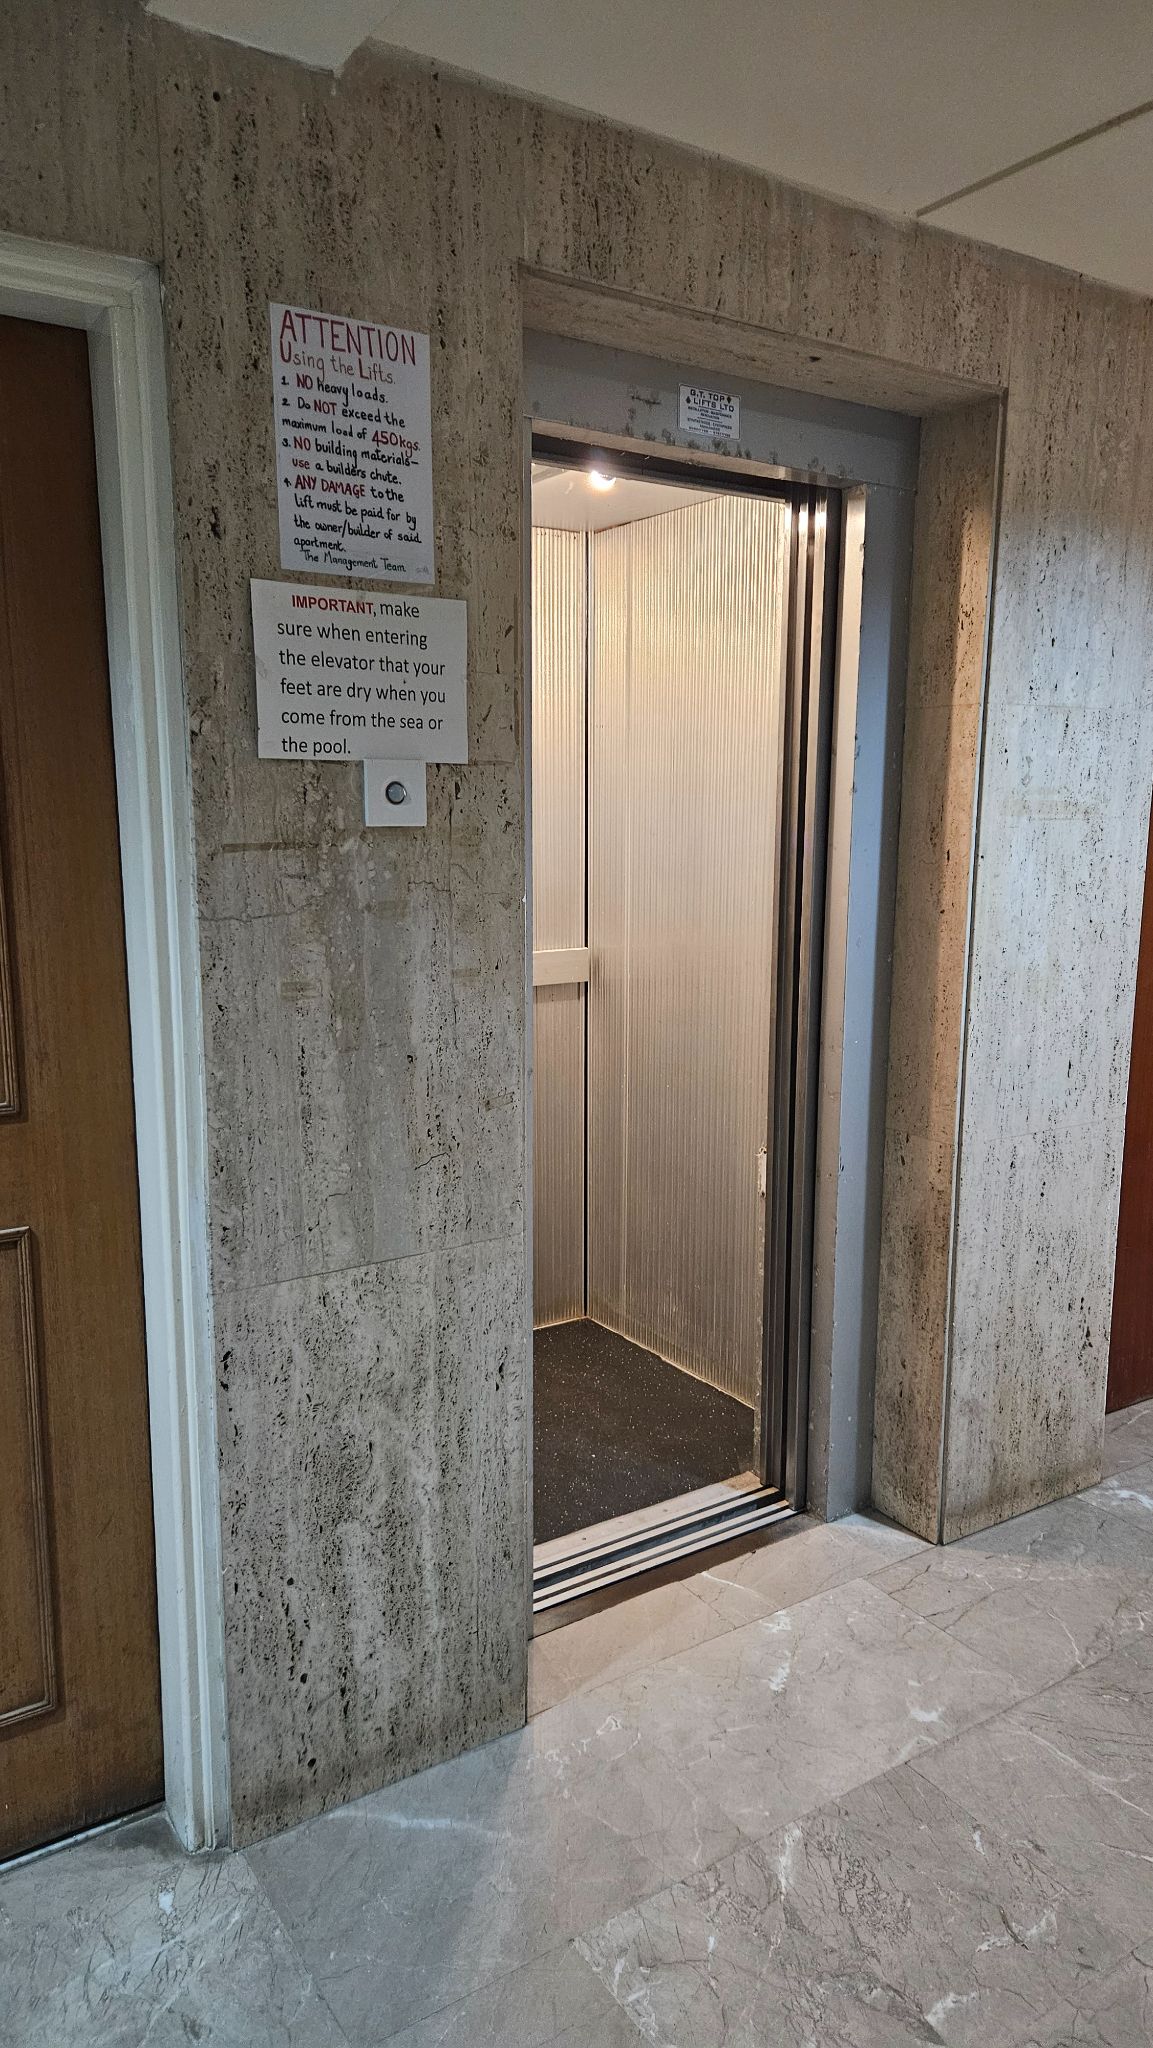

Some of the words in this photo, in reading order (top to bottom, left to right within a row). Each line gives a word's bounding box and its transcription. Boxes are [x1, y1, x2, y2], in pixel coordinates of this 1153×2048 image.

[280, 310, 416, 366] ATTENTION
[280, 340, 325, 382] Using
[330, 355, 354, 376] the
[296, 373, 314, 390] NO
[317, 377, 349, 407] heavy
[352, 383, 388, 404] loads.
[708, 392, 725, 402] TOP
[297, 397, 311, 410] Do
[314, 400, 337, 415] NOT
[342, 408, 382, 423] exceed
[384, 414, 406, 428] the
[694, 398, 716, 408] LIFTS
[720, 404, 734, 412] LTD
[282, 418, 326, 434] maximum
[332, 420, 353, 437] load
[357, 428, 367, 440] of
[294, 436, 311, 450] NO
[314, 438, 358, 467] building
[292, 458, 310, 470] use
[315, 462, 324, 471] a
[370, 468, 402, 484] chute.
[294, 474, 316, 490] ANY
[321, 479, 366, 498] DAMAGE
[370, 486, 384, 498] to
[385, 488, 404, 502] the
[294, 493, 314, 509] lift
[316, 500, 342, 514] must
[345, 500, 358, 516] be
[361, 508, 384, 522] paid
[386, 508, 400, 522] for
[406, 512, 416, 530] by
[294, 514, 310, 530] the
[384, 530, 392, 541] of
[398, 532, 422, 544] said
[294, 536, 346, 552] apartment.
[300, 550, 319, 562] The
[324, 552, 378, 570] Management
[380, 557, 406, 572] Team
[292, 594, 376, 617] IMPORTANT,
[380, 602, 420, 618] make
[278, 622, 312, 637] sure
[317, 624, 360, 642] when
[366, 630, 428, 650] entering
[279, 649, 306, 666] the
[312, 651, 375, 670] elevator
[379, 656, 409, 674] that
[413, 663, 446, 677] your
[280, 678, 312, 696] feet
[317, 684, 342, 697] are
[346, 682, 372, 702] dry
[376, 685, 416, 702] when
[420, 692, 446, 706] you
[282, 711, 324, 725] come
[330, 710, 366, 727] from
[371, 712, 396, 728] the
[400, 717, 423, 730] sea
[428, 718, 444, 730] or
[282, 736, 307, 753] the
[313, 738, 351, 756] pool.
